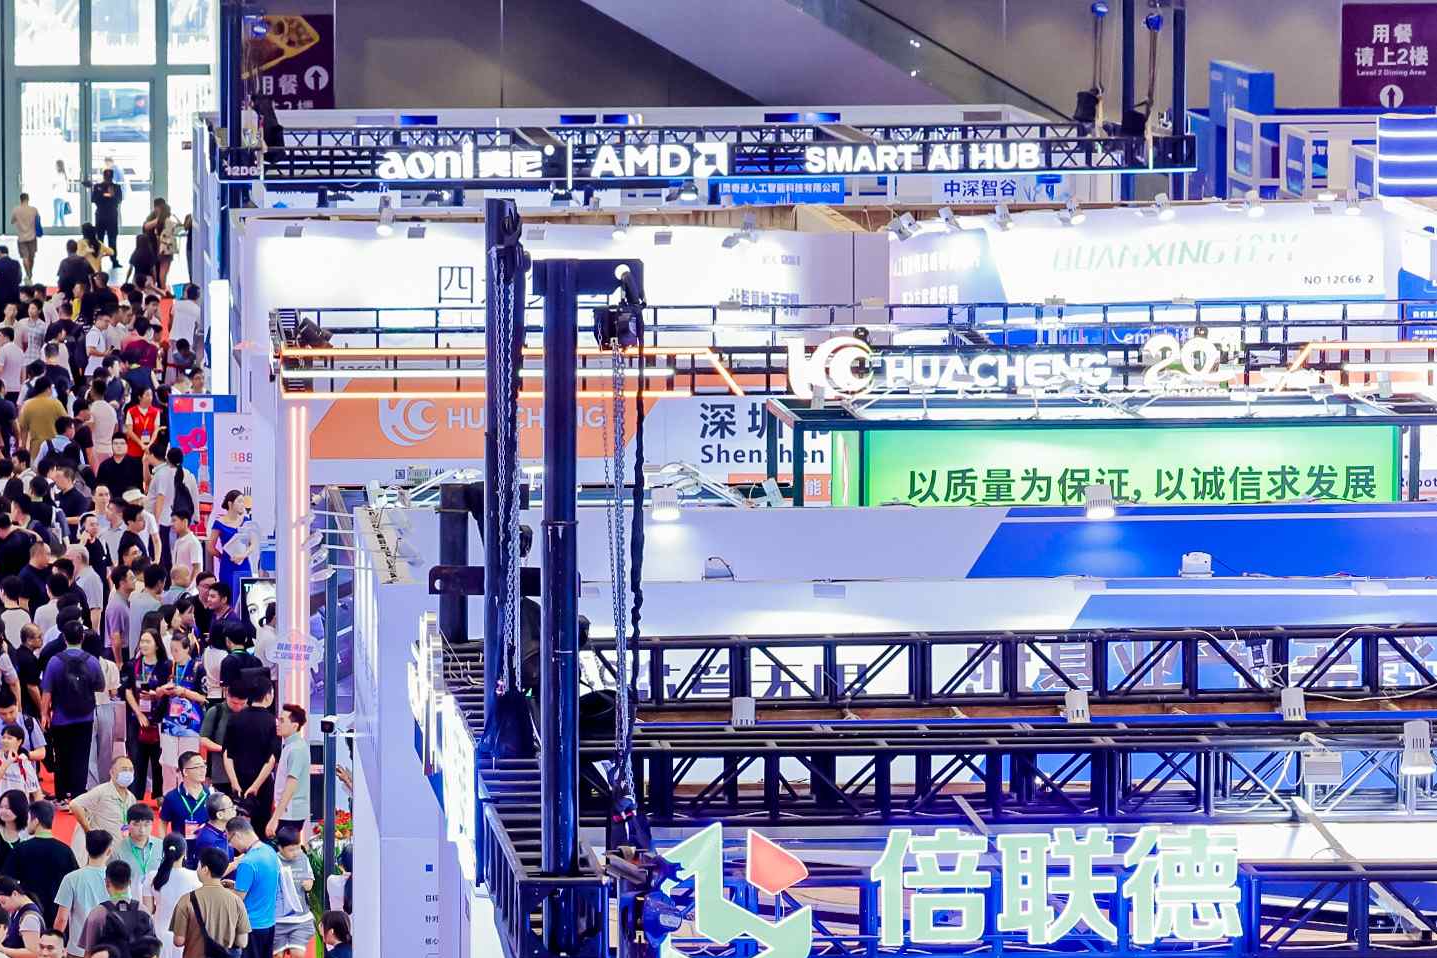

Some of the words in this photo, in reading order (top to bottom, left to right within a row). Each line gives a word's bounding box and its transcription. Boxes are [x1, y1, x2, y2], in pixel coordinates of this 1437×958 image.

[1372, 24, 1412, 44] 用餐
[1355, 45, 1428, 66] 请上2楼
[1384, 69, 1408, 77] Dining
[591, 145, 692, 177] AMD
[806, 147, 921, 174] SMART
[927, 146, 960, 172] AI
[969, 144, 1041, 170] HUB
[944, 179, 1017, 197] 中深智谷
[884, 355, 1112, 387] HUACHENG
[871, 826, 1244, 947] 倍联德
